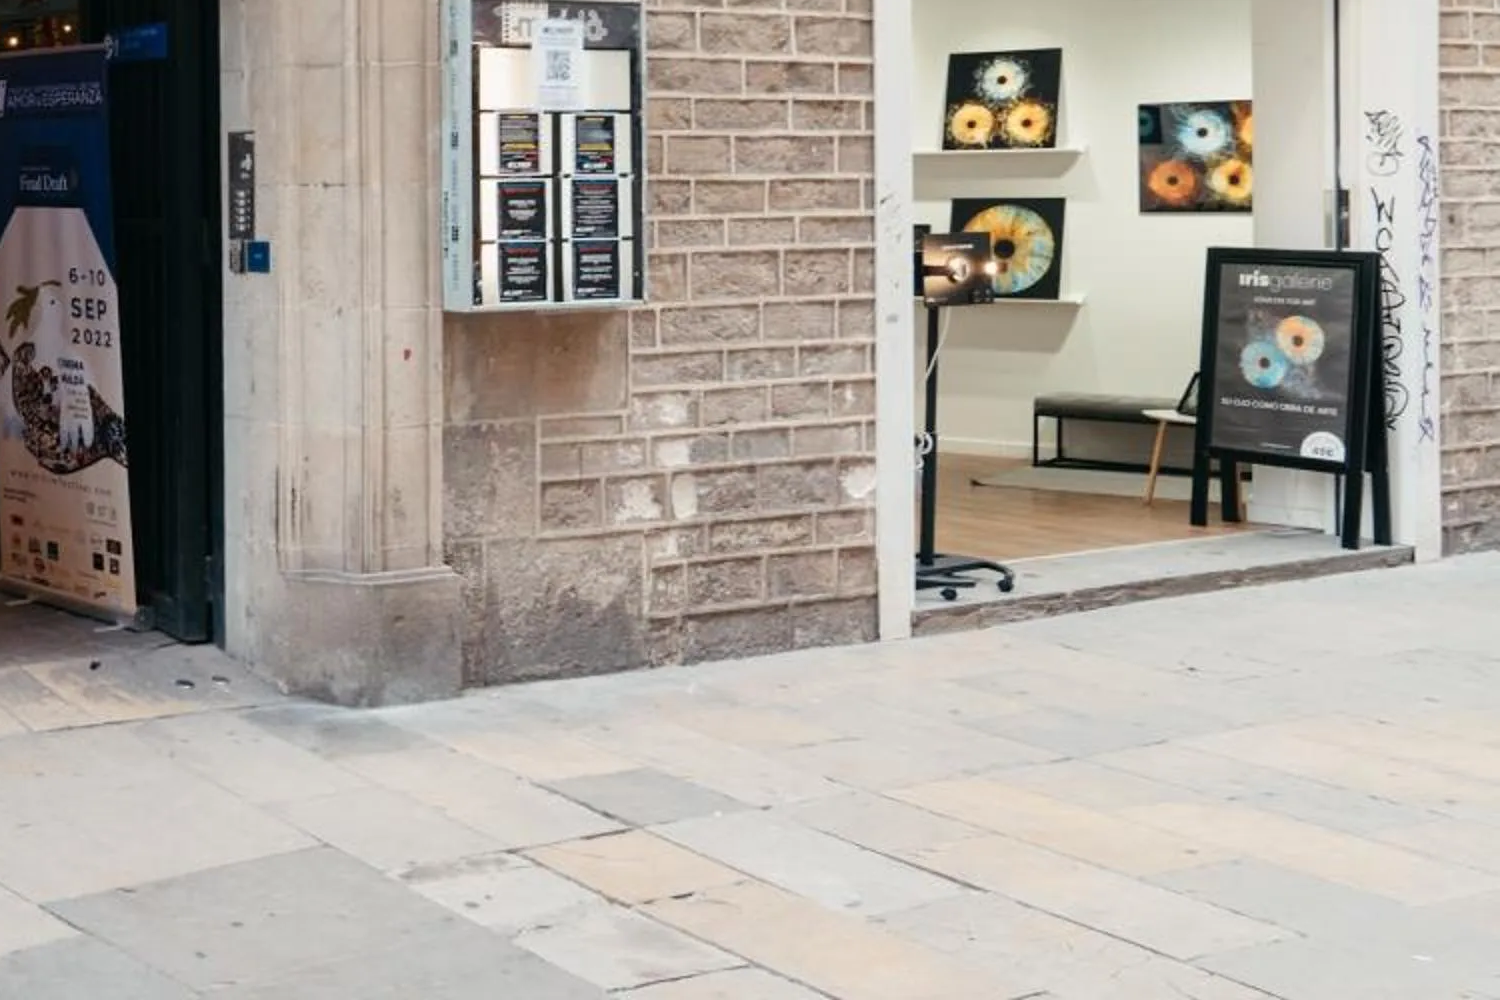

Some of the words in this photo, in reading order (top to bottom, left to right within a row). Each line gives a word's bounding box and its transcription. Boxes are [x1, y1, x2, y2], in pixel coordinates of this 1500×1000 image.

[68, 267, 106, 286] 6-10
[70, 297, 107, 321] SEP
[71, 328, 112, 348] 2022
